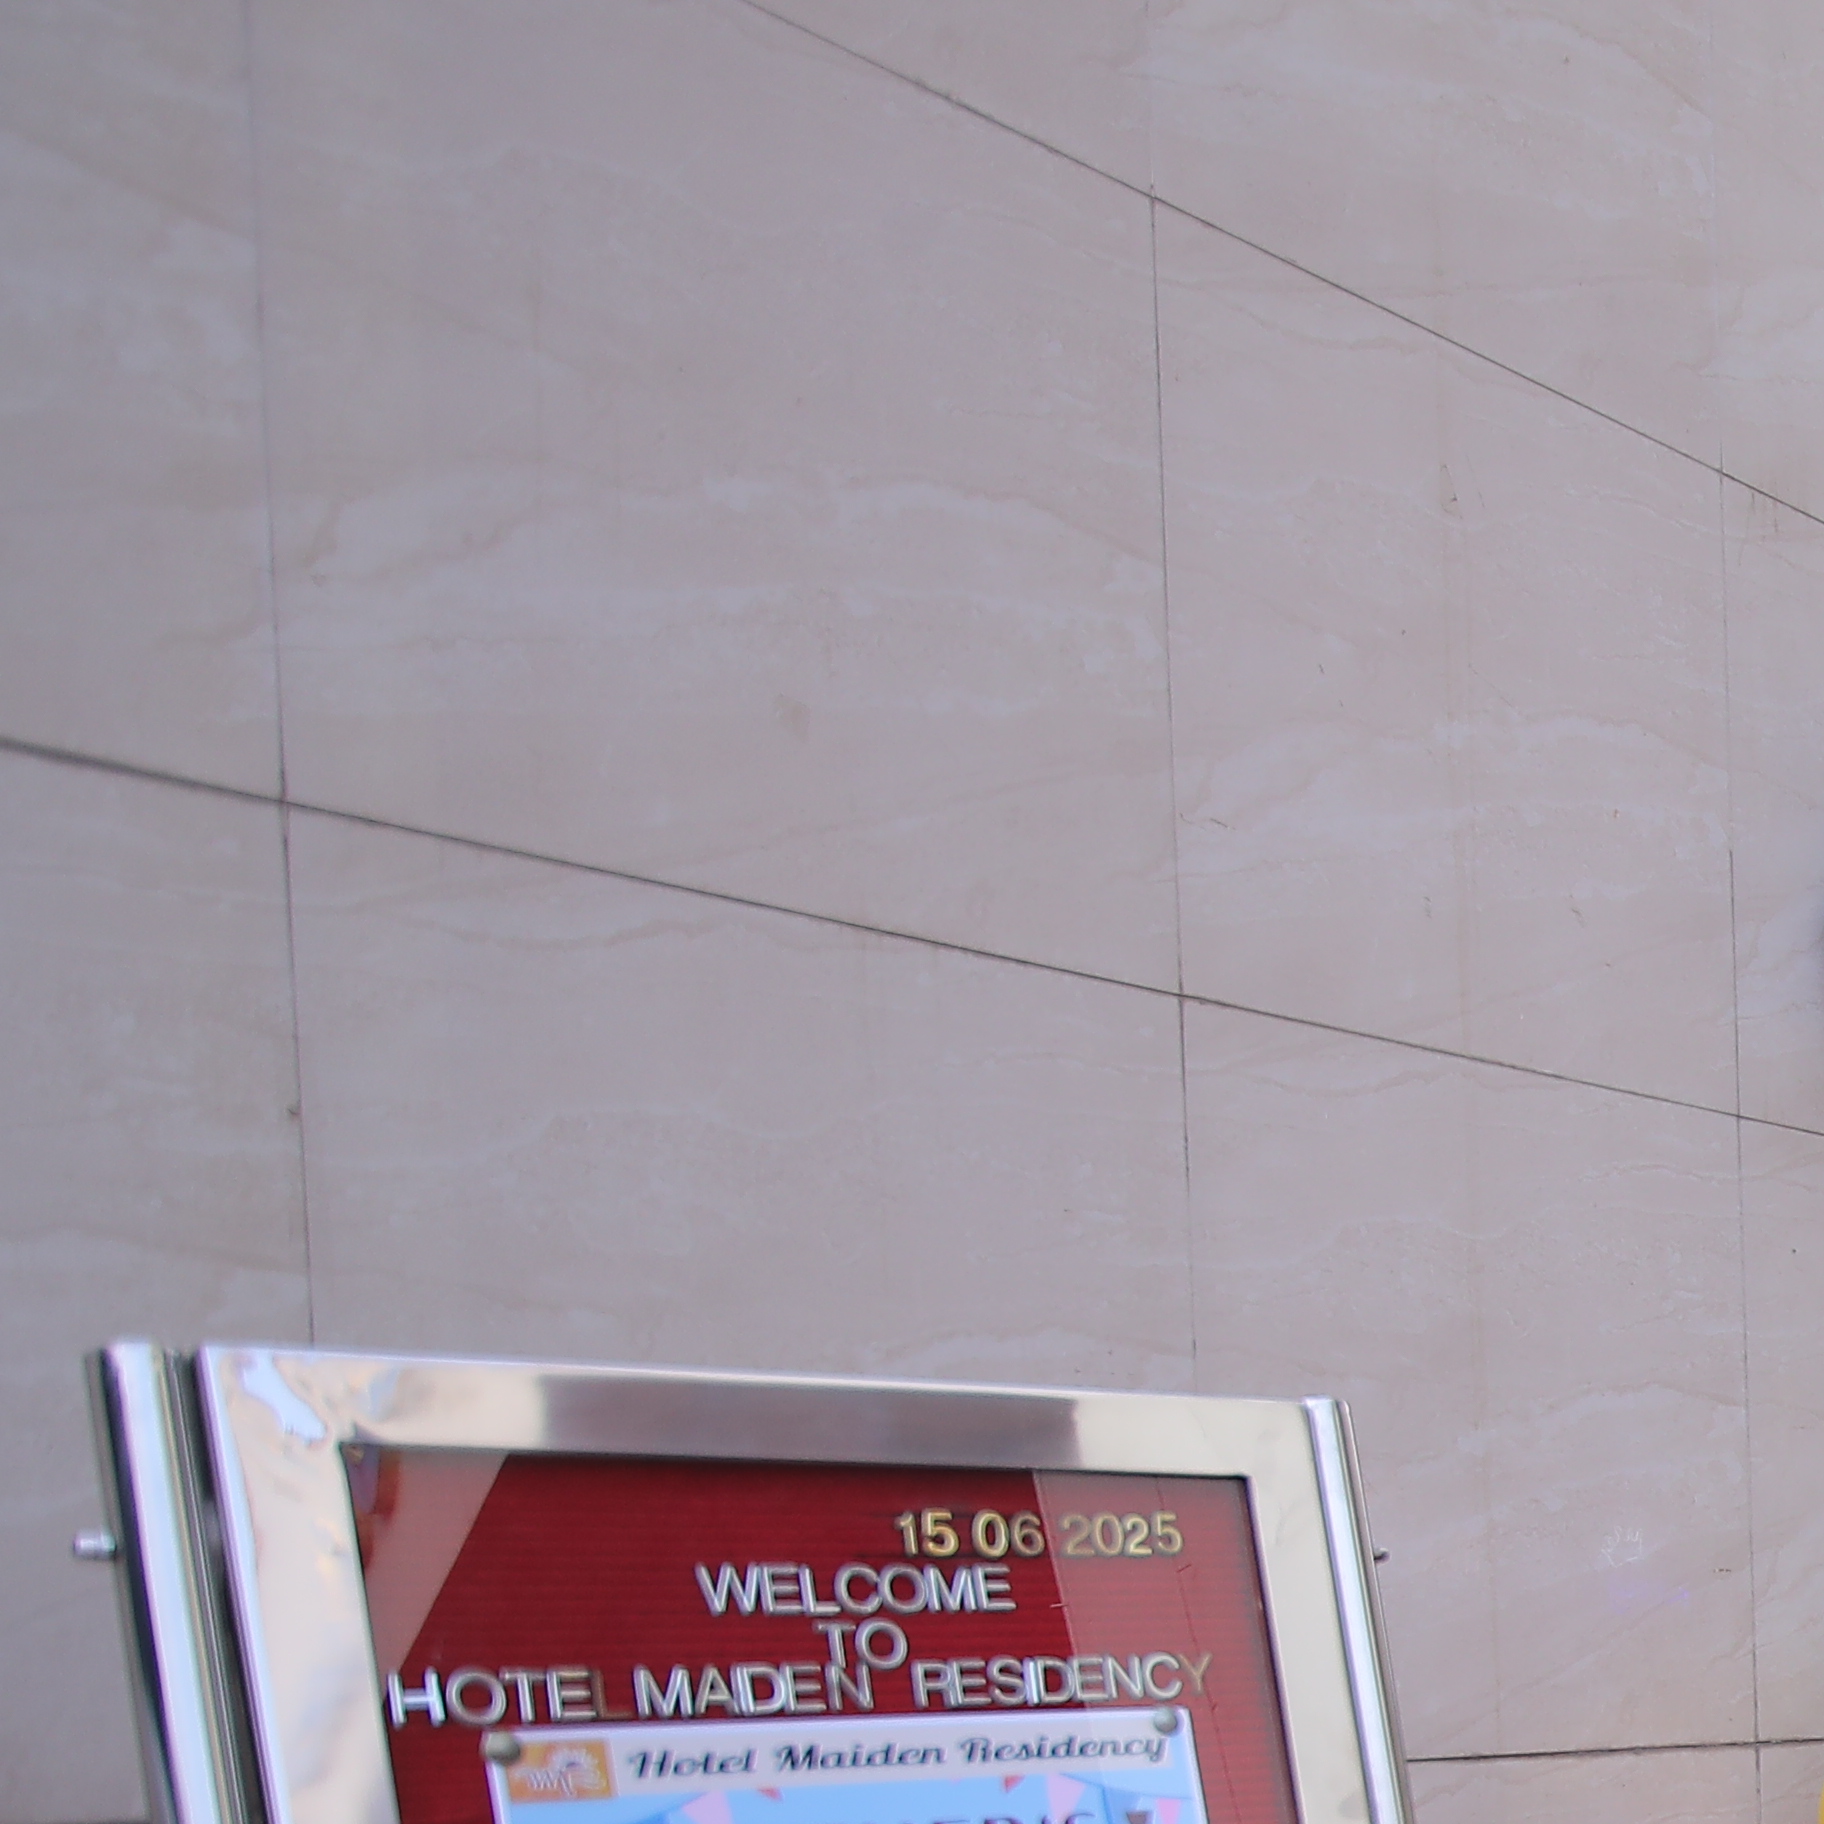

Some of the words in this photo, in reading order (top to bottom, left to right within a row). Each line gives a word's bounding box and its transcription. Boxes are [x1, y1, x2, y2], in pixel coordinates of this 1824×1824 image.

[897, 1507, 960, 1557] 15
[972, 1509, 1046, 1558] 06
[1060, 1510, 1185, 1557] 2025
[695, 1561, 1016, 1616] WELCOME
[812, 1617, 909, 1670] TO
[385, 1664, 633, 1728] HOTEL
[632, 1660, 875, 1719] MADEN
[910, 1650, 1213, 1709] RESIDENCY
[628, 1748, 757, 1780] Hotel
[774, 1742, 948, 1773] Maiden
[961, 1732, 1169, 1764] Residency
